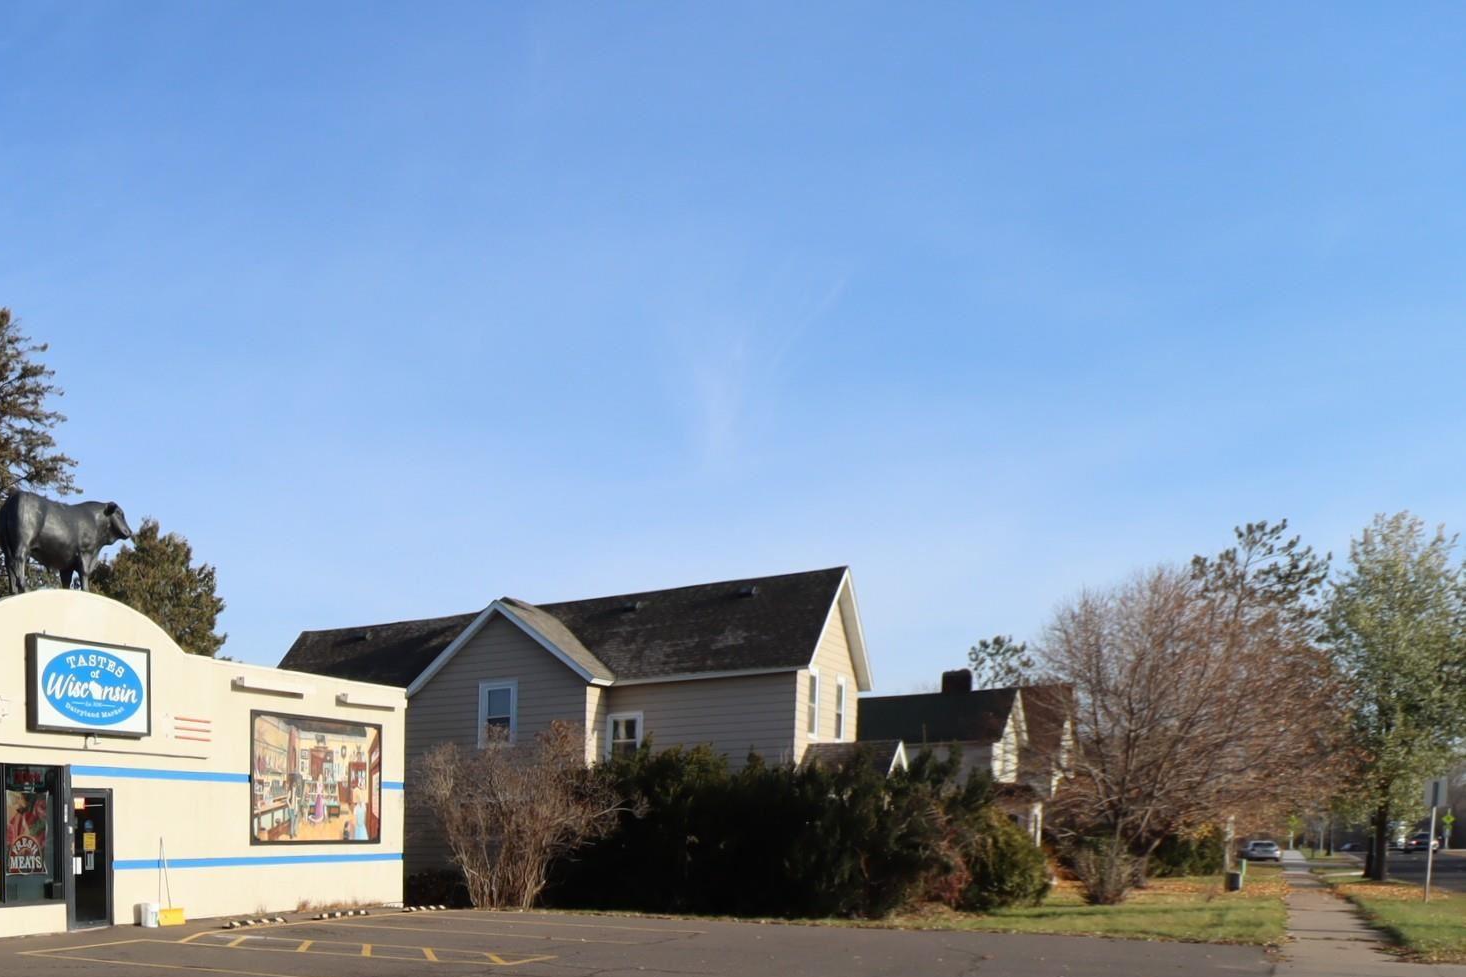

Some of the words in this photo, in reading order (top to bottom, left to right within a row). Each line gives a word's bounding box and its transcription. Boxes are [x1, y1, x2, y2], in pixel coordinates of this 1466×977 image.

[66, 654, 125, 678] TASTES
[90, 670, 101, 679] of
[65, 702, 100, 719] Dairyland
[101, 706, 125, 718] Market
[12, 838, 39, 855] FRESH
[10, 855, 43, 869] MEATS
